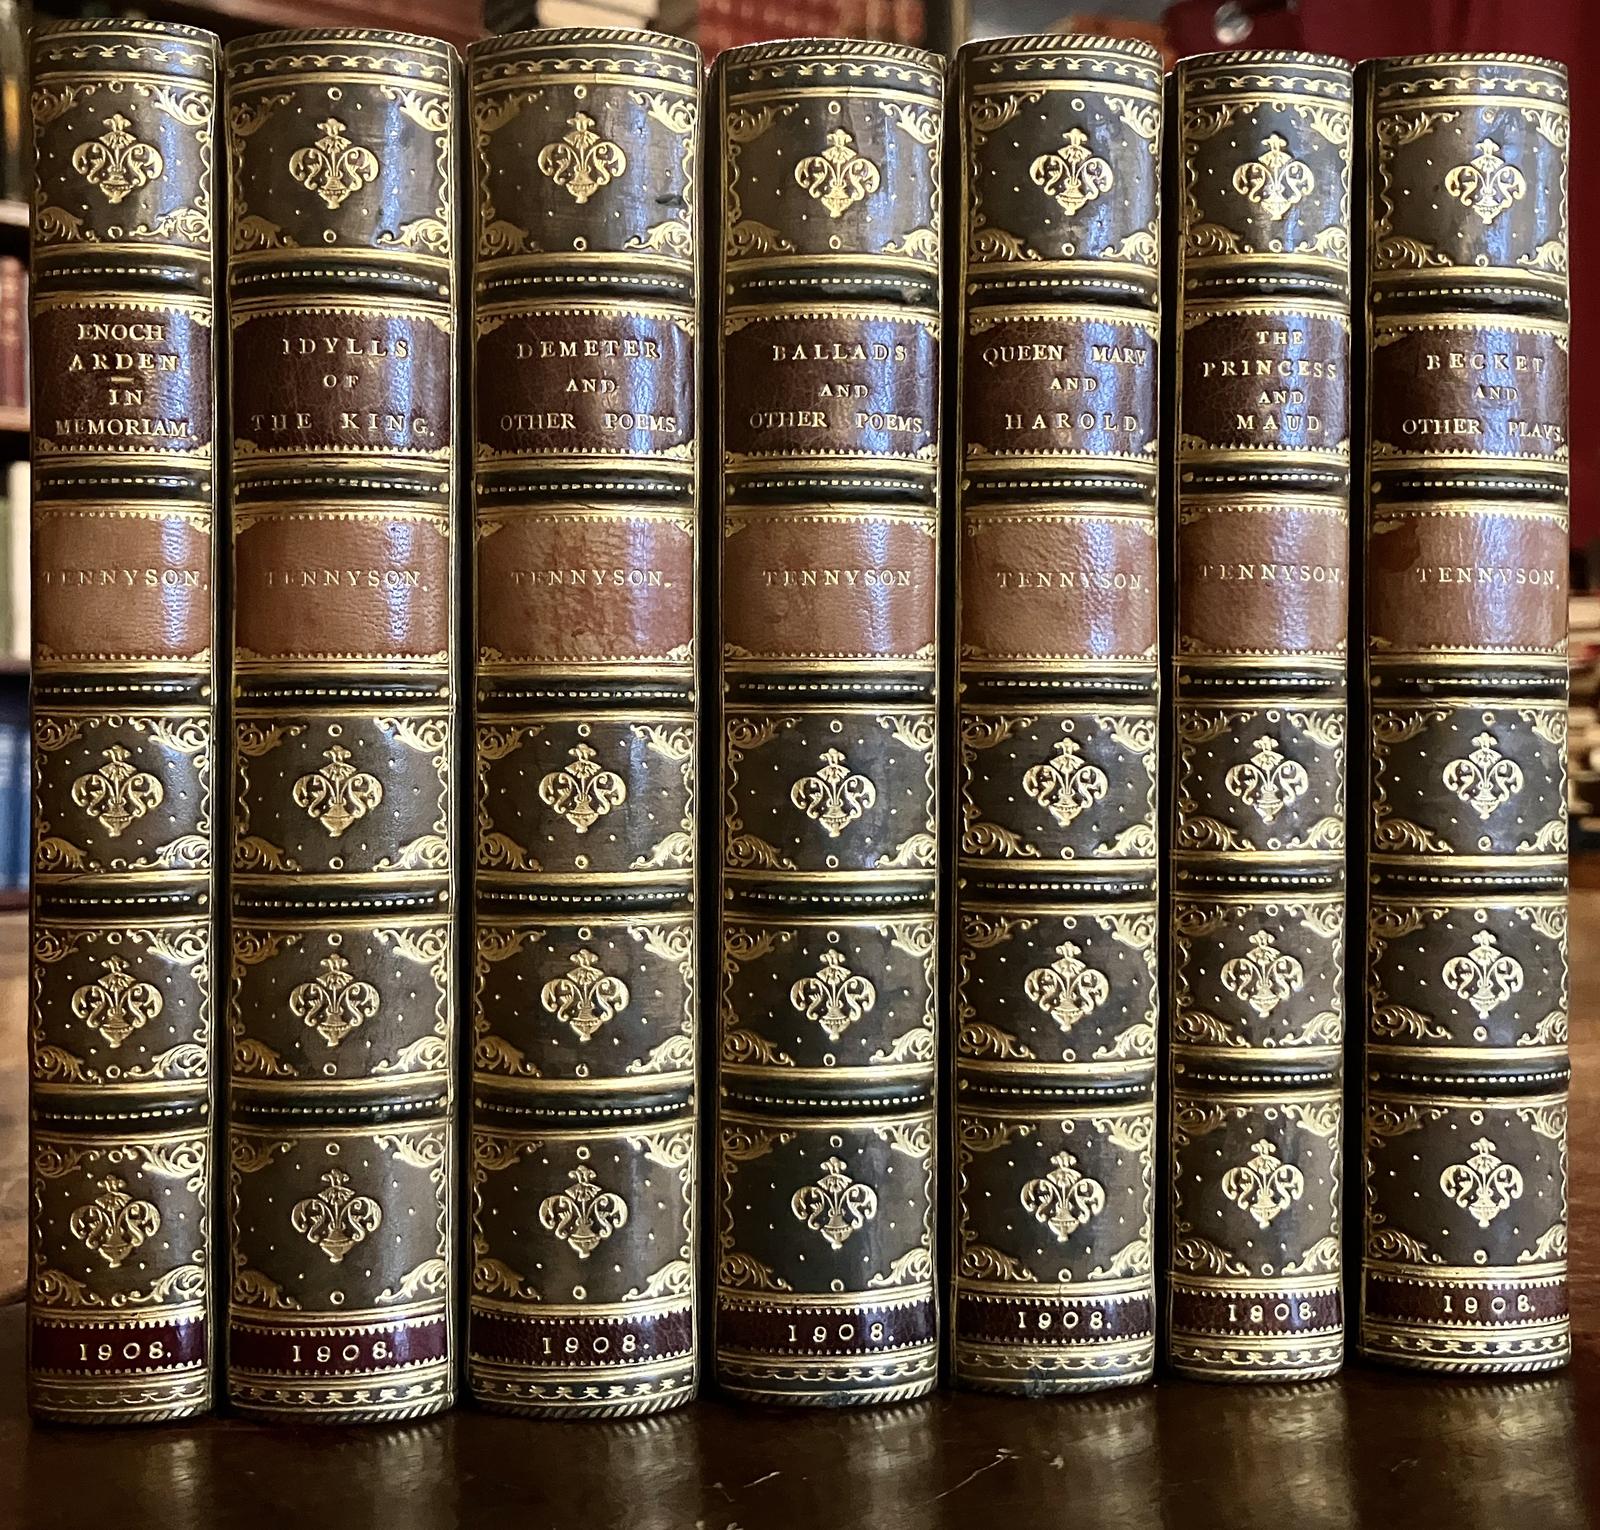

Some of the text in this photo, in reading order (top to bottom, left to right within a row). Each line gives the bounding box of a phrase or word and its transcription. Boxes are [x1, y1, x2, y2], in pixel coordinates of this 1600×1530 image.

[77, 324, 164, 342] ENOCH
[1257, 331, 1304, 345] THE
[282, 338, 409, 358] IDYLLS
[517, 340, 660, 359] DEMETER
[772, 345, 907, 361] BALLADS
[983, 344, 1147, 367] QUEEN MARY
[69, 353, 179, 372] ARDEN
[1203, 360, 1338, 381] PRINCESS
[1427, 353, 1544, 372] BECKET
[323, 374, 359, 388] OF
[566, 379, 617, 394] AND
[1050, 377, 1098, 391] AND
[109, 389, 144, 406] IN
[820, 384, 869, 398] AND
[1258, 391, 1304, 405] AND
[1474, 386, 1518, 400] AND
[56, 419, 199, 441] MEMORIAM.
[251, 413, 435, 437] THE KING.
[500, 413, 577, 432] OTHER
[750, 411, 828, 430] OTHER
[1005, 413, 1144, 435] HAROLD.
[1236, 414, 1329, 436] MAUD.
[1402, 418, 1483, 435] OTHER
[510, 569, 673, 588] TENNYSON.
[996, 571, 1149, 593] TENNYSON.
[1228, 1302, 1317, 1322] 1908.
[1443, 1295, 1536, 1313] 1908.
[1018, 1311, 1112, 1329] 1908.
[788, 1323, 894, 1342] 1908.
[79, 1341, 172, 1361] 1908.
[292, 1341, 393, 1362] 1908.
[542, 1334, 650, 1354] 1908.
